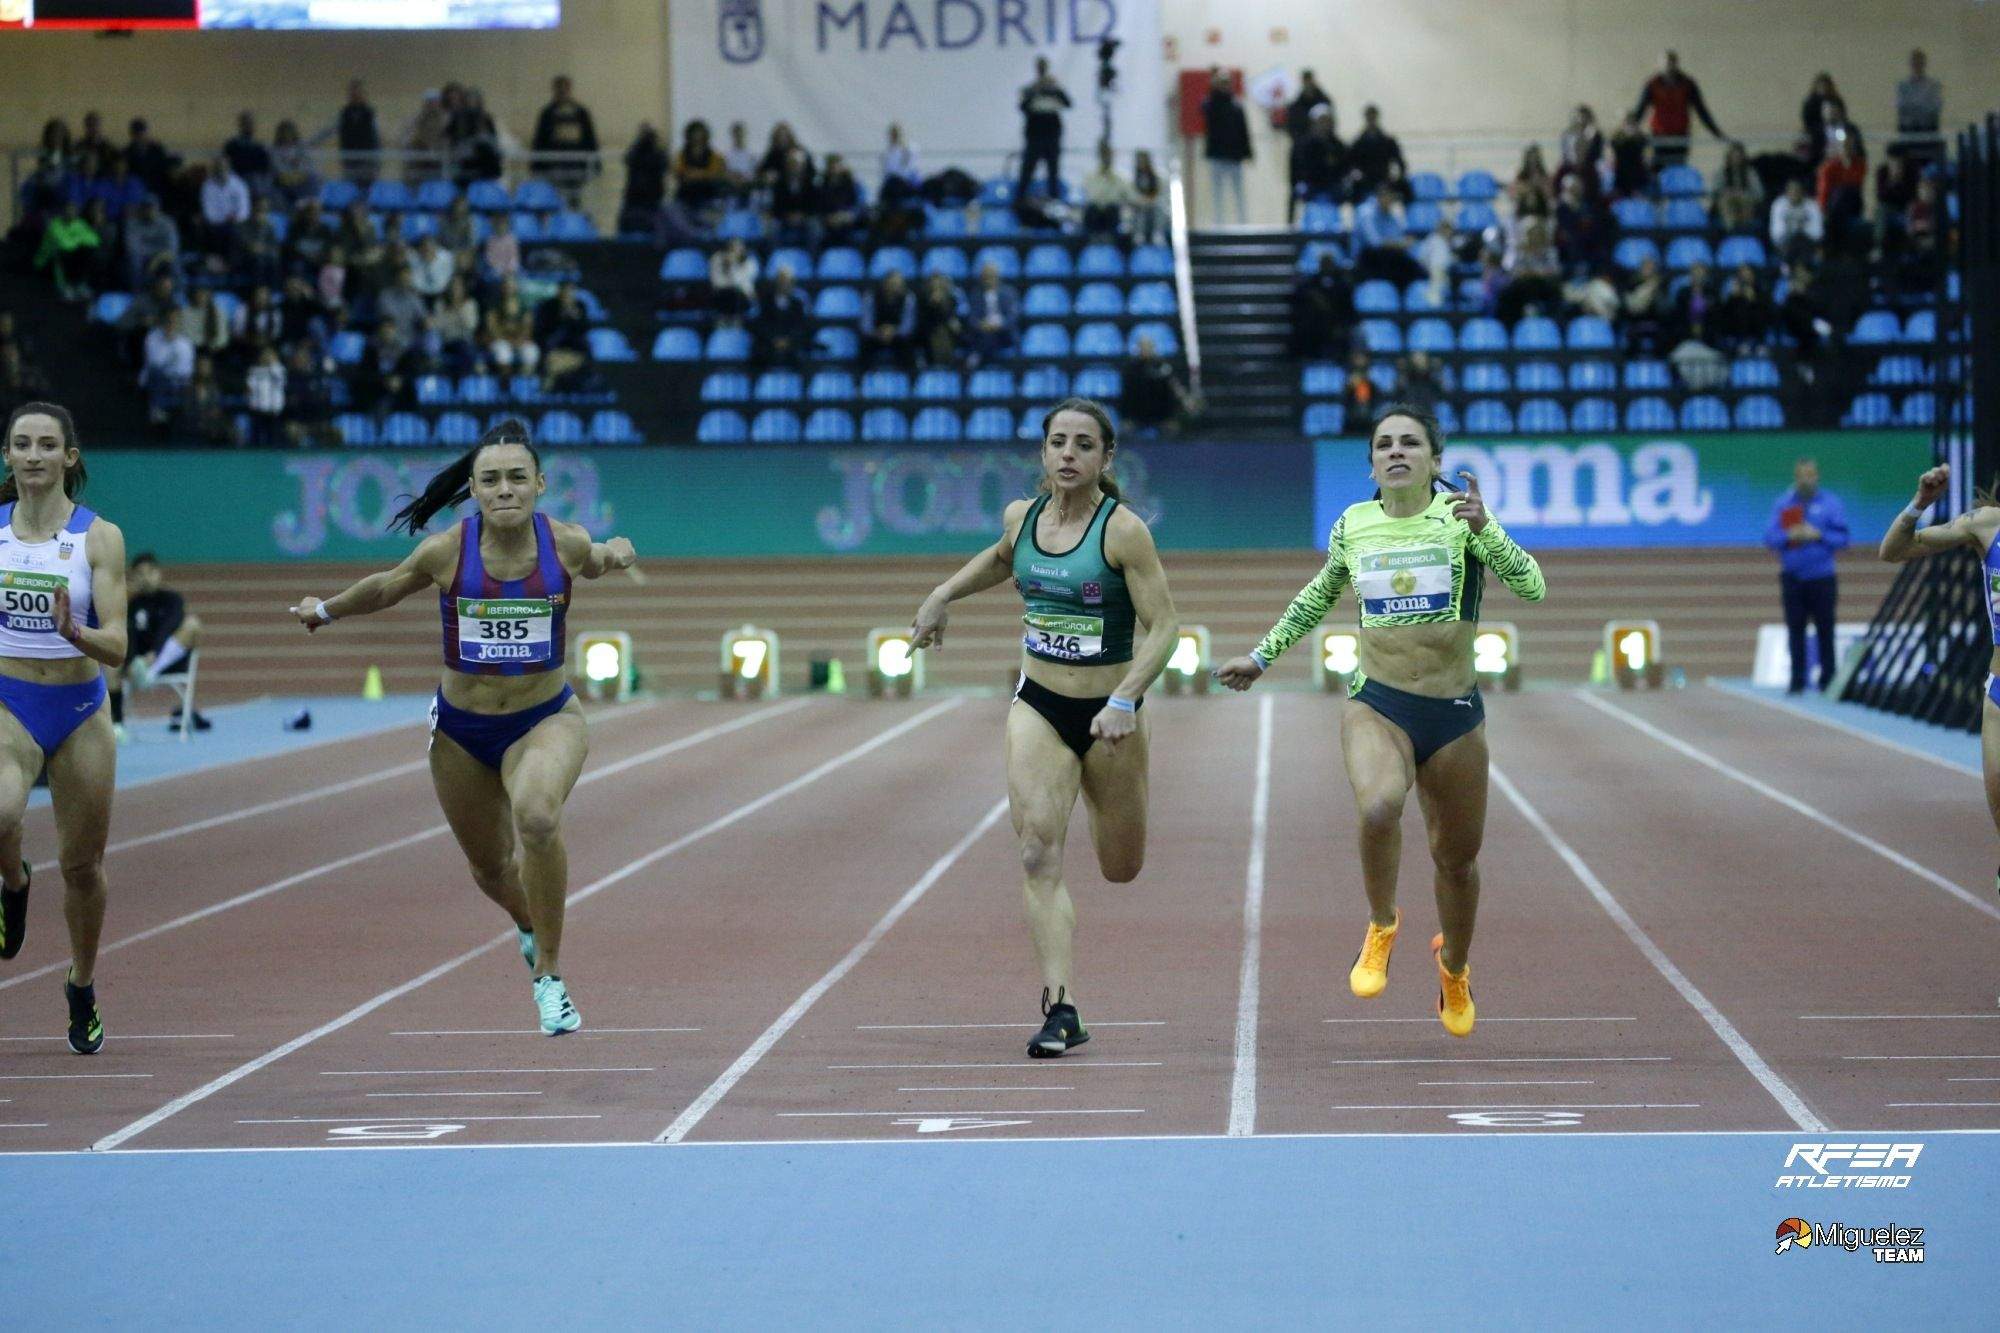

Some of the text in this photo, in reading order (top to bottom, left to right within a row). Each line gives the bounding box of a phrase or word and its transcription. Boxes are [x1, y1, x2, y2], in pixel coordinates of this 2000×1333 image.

[817, 0, 1118, 51] MADRID
[1440, 439, 1712, 526] oma
[1389, 554, 1436, 565] IBERDROLA
[6, 591, 49, 613] 500
[487, 605, 543, 615] IBERDROLA
[1382, 596, 1431, 614] Joma
[480, 620, 529, 639] 385
[478, 644, 531, 659] Joma
[1038, 632, 1081, 654] 346
[1620, 631, 1645, 670] 1
[733, 640, 767, 679] 7
[1167, 637, 1200, 676] 4
